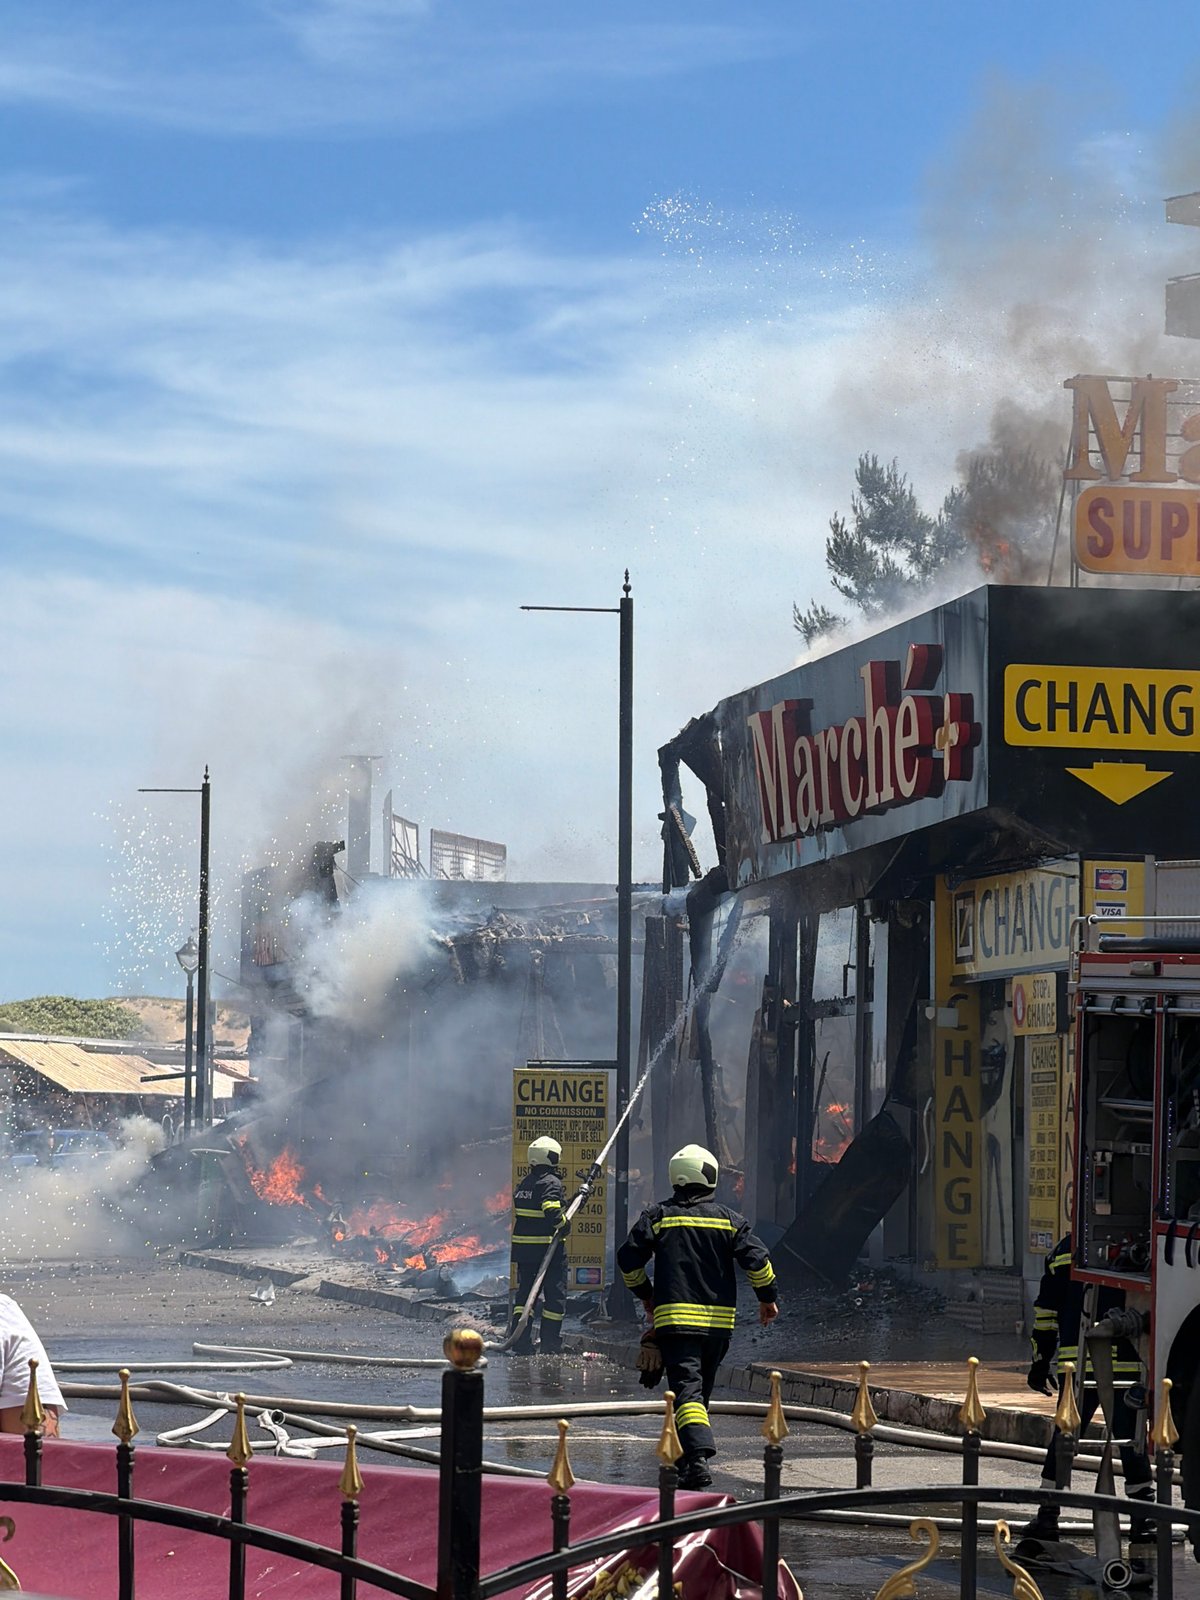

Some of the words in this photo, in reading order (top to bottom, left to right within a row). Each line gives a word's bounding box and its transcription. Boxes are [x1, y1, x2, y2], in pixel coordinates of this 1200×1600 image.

[1087, 497, 1200, 561] SUP
[980, 876, 1075, 958] CHANGE
[1101, 908, 1122, 916] VISA
[1027, 1003, 1055, 1027] CHANGE
[517, 1079, 604, 1103] CHANGE
[525, 1107, 537, 1115] NO
[540, 1107, 597, 1116] COMMISSION
[581, 1149, 597, 1160] BGN
[578, 1222, 602, 1233] 3850
[583, 1255, 602, 1264] CARDS
